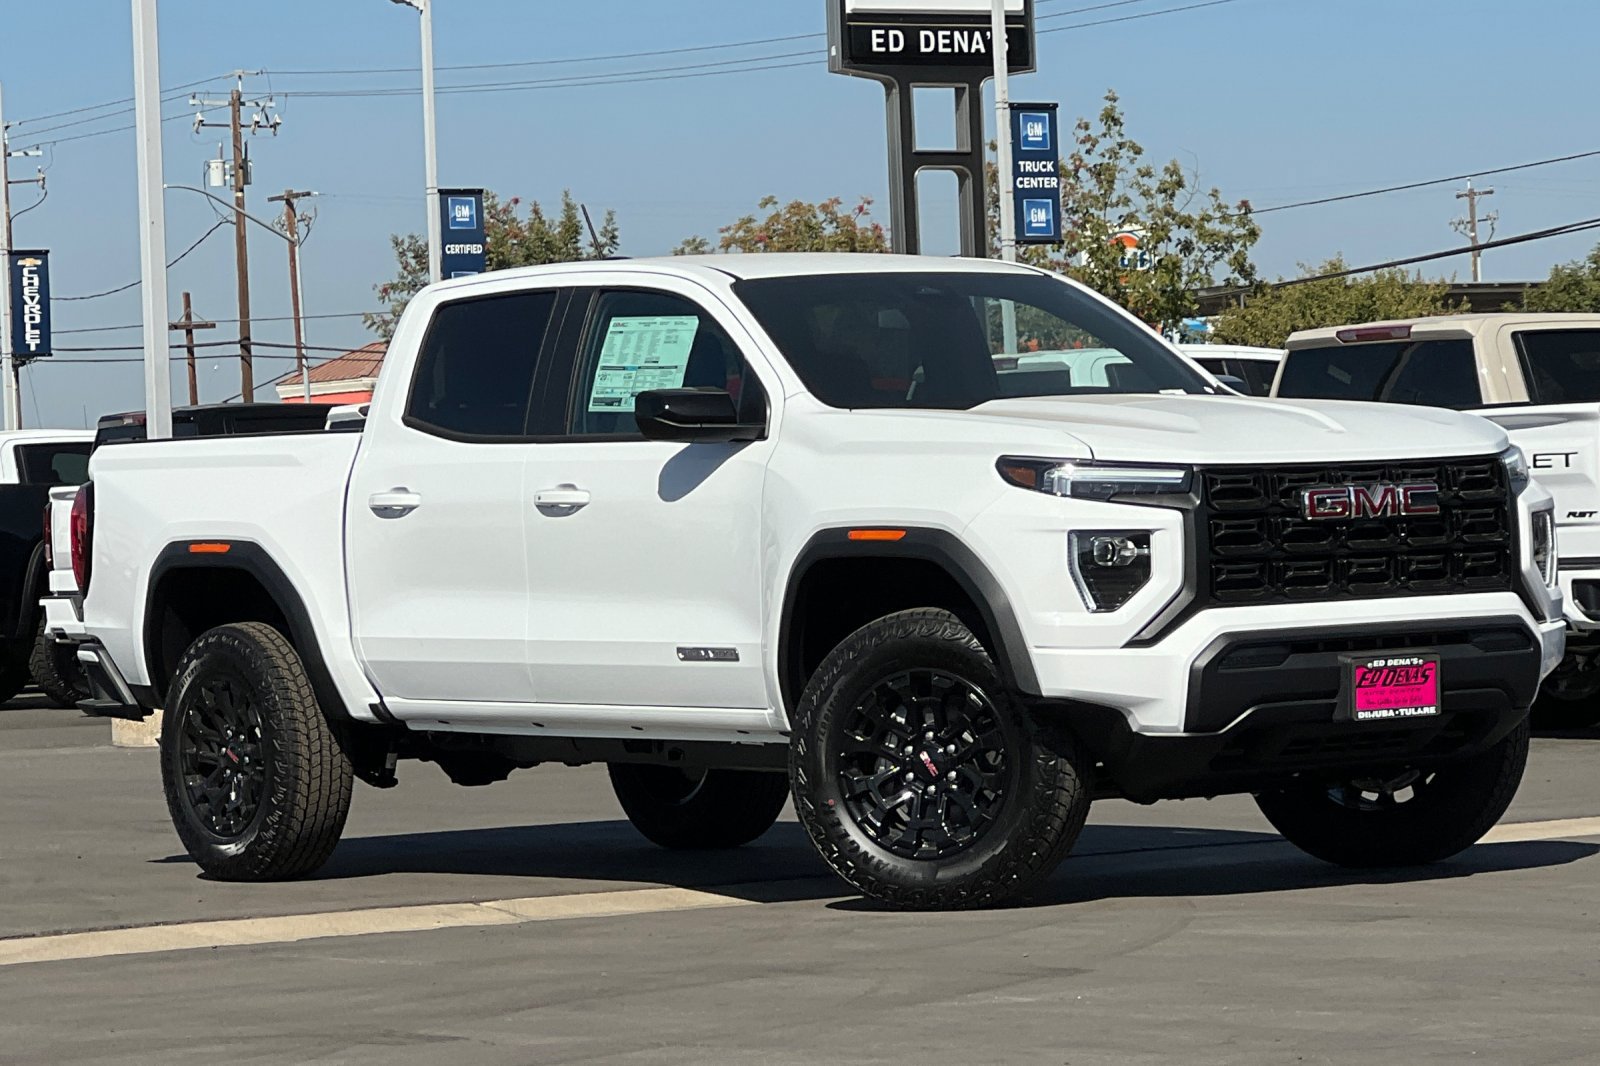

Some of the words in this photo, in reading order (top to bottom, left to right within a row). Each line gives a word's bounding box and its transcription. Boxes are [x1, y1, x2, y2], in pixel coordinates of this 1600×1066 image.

[871, 29, 905, 52] ED
[1027, 121, 1043, 137] GM
[1018, 160, 1054, 172] TRUCK
[1016, 176, 1058, 188] CENTER
[455, 204, 470, 218] GM
[1030, 207, 1047, 223] GM
[444, 244, 483, 254] CERTIFIED
[22, 266, 42, 352] CHEVROLET
[1527, 451, 1579, 469] ET
[1303, 484, 1440, 520] GMC
[1373, 659, 1386, 667] ED
[1387, 658, 1418, 667] DENA'S
[1356, 669, 1383, 688] ED
[1399, 706, 1437, 716] TULARE
